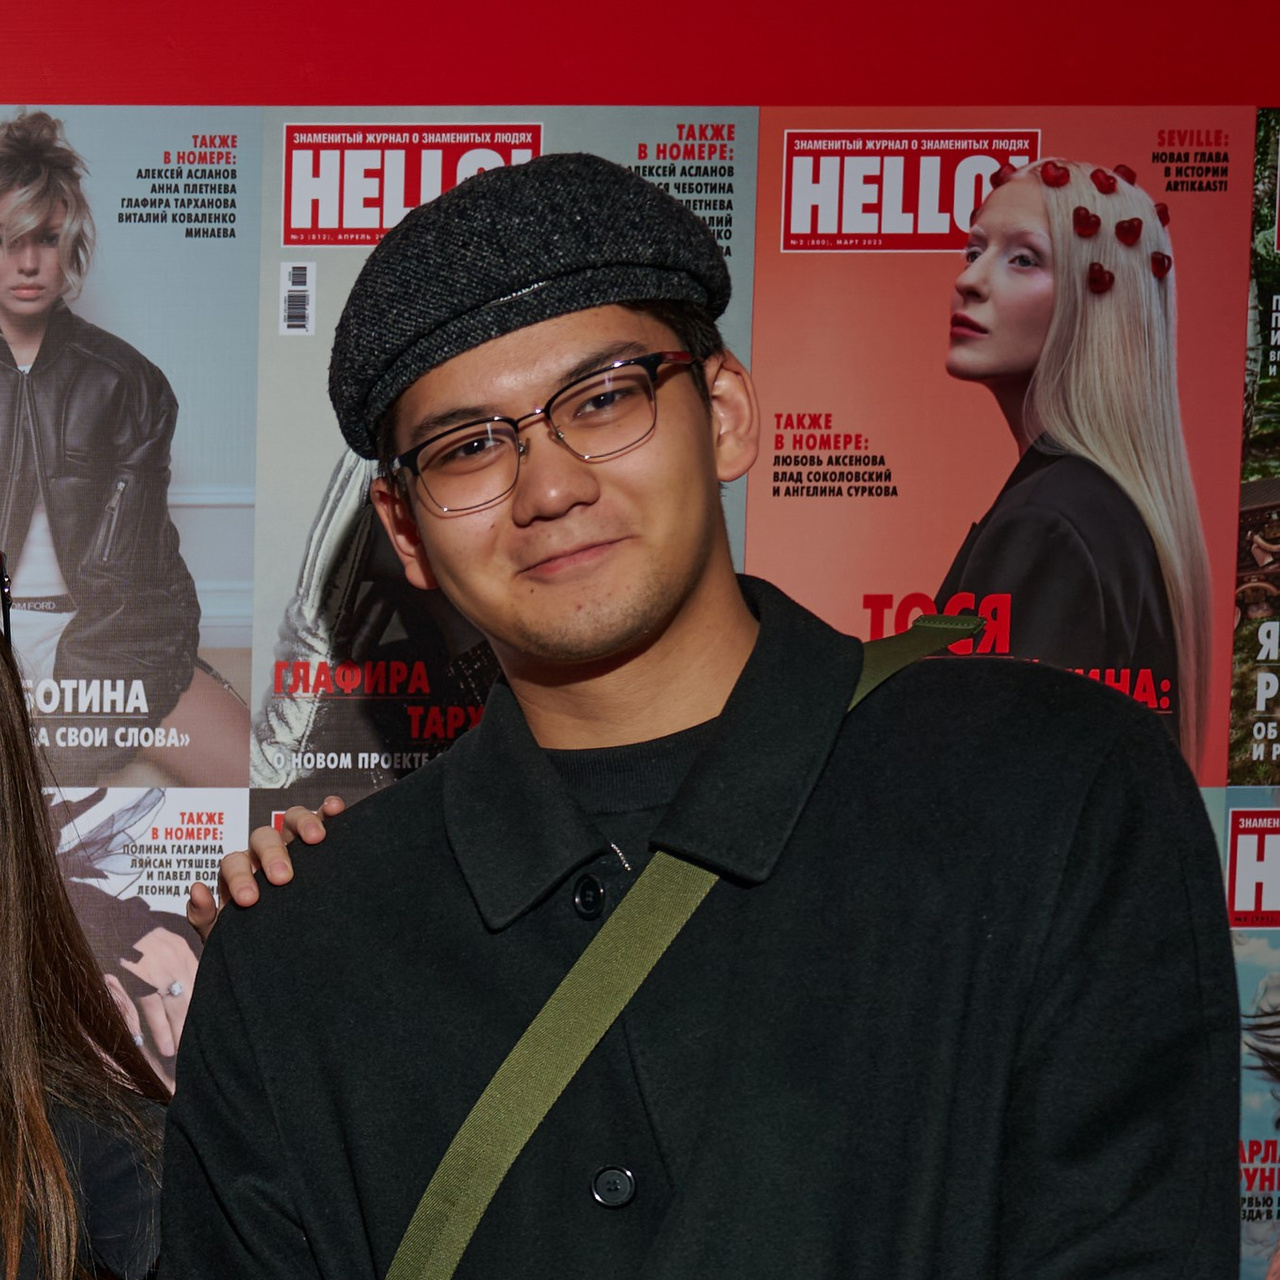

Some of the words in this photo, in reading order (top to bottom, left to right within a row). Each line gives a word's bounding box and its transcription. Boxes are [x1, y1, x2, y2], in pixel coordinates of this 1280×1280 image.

[293, 131, 363, 144] ЗНАМЕНИТЫЙ
[366, 133, 409, 143] ЖУРНАЛ
[422, 133, 491, 143] ЗНАМЕНИТЫХ
[494, 133, 532, 144] ЛЮДЯХ
[677, 124, 735, 140] ТАКЖЕ
[1158, 129, 1229, 147] SEVILLE:
[192, 135, 237, 148] ТАКЖЕ
[794, 138, 862, 150] ЗНАМЕНИТЫЙ
[865, 140, 908, 150] ЖУРНАЛ
[921, 140, 989, 150] ЗНАМЕНИТЫХ
[992, 140, 1029, 151] ЛЮДЯХ
[163, 151, 171, 164] В
[177, 151, 236, 164] НОМЕРЕ:
[638, 143, 648, 160] В
[656, 143, 734, 160] НОМЕРЕ:
[1152, 152, 1190, 163] НОВАЯ
[1194, 152, 1229, 163] ГЛАВА
[137, 167, 183, 179] АЛЕКСЕЙ
[187, 169, 237, 179] АСЛАНОВ
[680, 166, 734, 177] АСЛАНОВ
[1176, 166, 1228, 177] ИСТОРИИ
[151, 184, 180, 193] АННА
[184, 184, 237, 193] ПЛЕТНЕВА
[674, 183, 734, 194] ЧЕБОТИНА
[1166, 181, 1227, 192] ARTIK&ASTI
[121, 198, 170, 208] ГЛАФИРА
[174, 199, 236, 208] ТАРХАНОВА
[118, 211, 167, 223] ВИТАЛИЙ
[172, 213, 236, 223] КОВАЛЕНКО
[185, 228, 236, 238] МИНАЕВА
[774, 413, 832, 430] ТАКЖЕ
[775, 434, 784, 450] В
[792, 434, 869, 450] НОМЕРЕ:
[773, 455, 823, 466] ЛЮБОВЬ
[827, 455, 885, 466] АКСЕНОВА
[773, 471, 803, 484] ВЛАД
[807, 469, 891, 482] СОКОЛОВСКИЙ
[784, 486, 843, 497] АНГЕЛИНА
[847, 486, 898, 497] СУРКОВА
[274, 660, 430, 694] ГЛАФИРА
[55, 727, 107, 747] СВОИ
[115, 727, 190, 747] СЛОВА»
[292, 753, 352, 769] НОВОМ
[358, 753, 429, 769] ПРОЕКТЕ
[180, 812, 224, 825] ТАКЖЕ
[165, 828, 223, 840] НОМЕРЕ:
[123, 845, 167, 854] ПОЛИНА
[171, 845, 223, 854] ГАГАРИНА
[131, 857, 172, 868] ЛЯЙСАН
[158, 871, 190, 880] ПАВЕЛ
[137, 885, 180, 896] ЛЕОНИД
